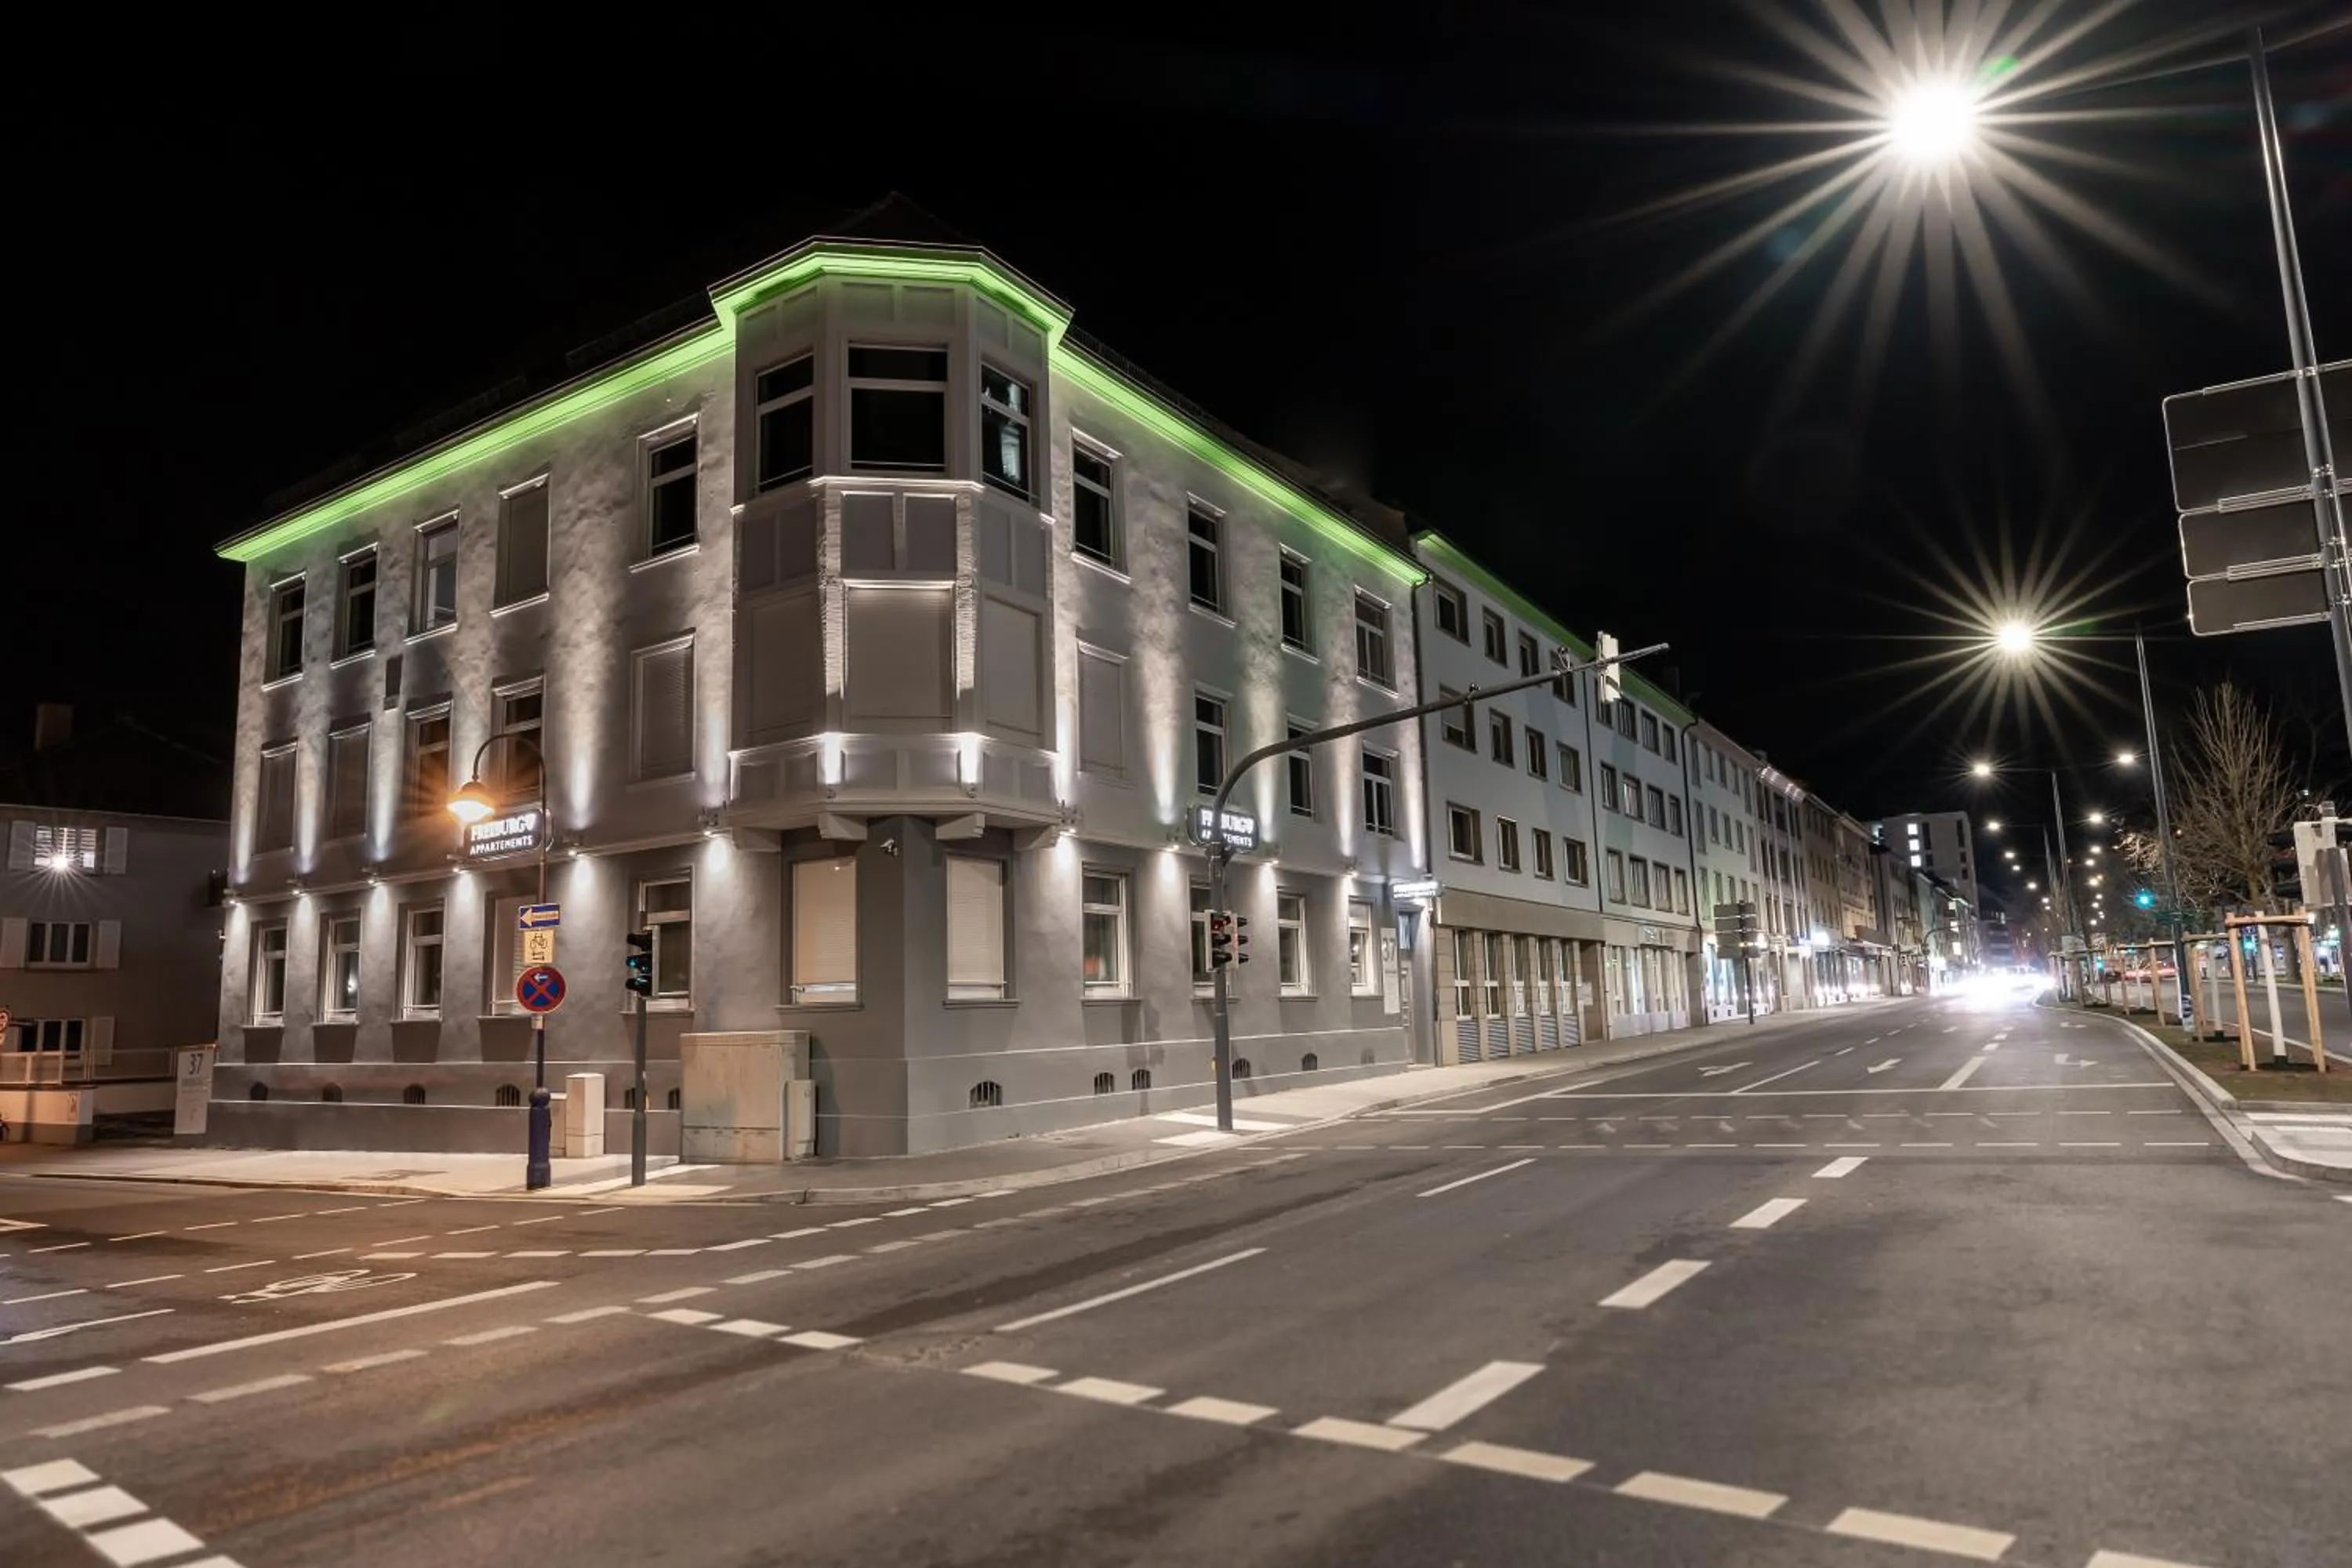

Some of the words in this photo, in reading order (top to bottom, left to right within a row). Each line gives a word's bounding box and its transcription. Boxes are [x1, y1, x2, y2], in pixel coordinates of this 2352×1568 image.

[470, 836, 532, 855] APPARTEMENTS
[1202, 829, 1252, 848] APTEMENTS
[188, 1053, 204, 1076] 37
